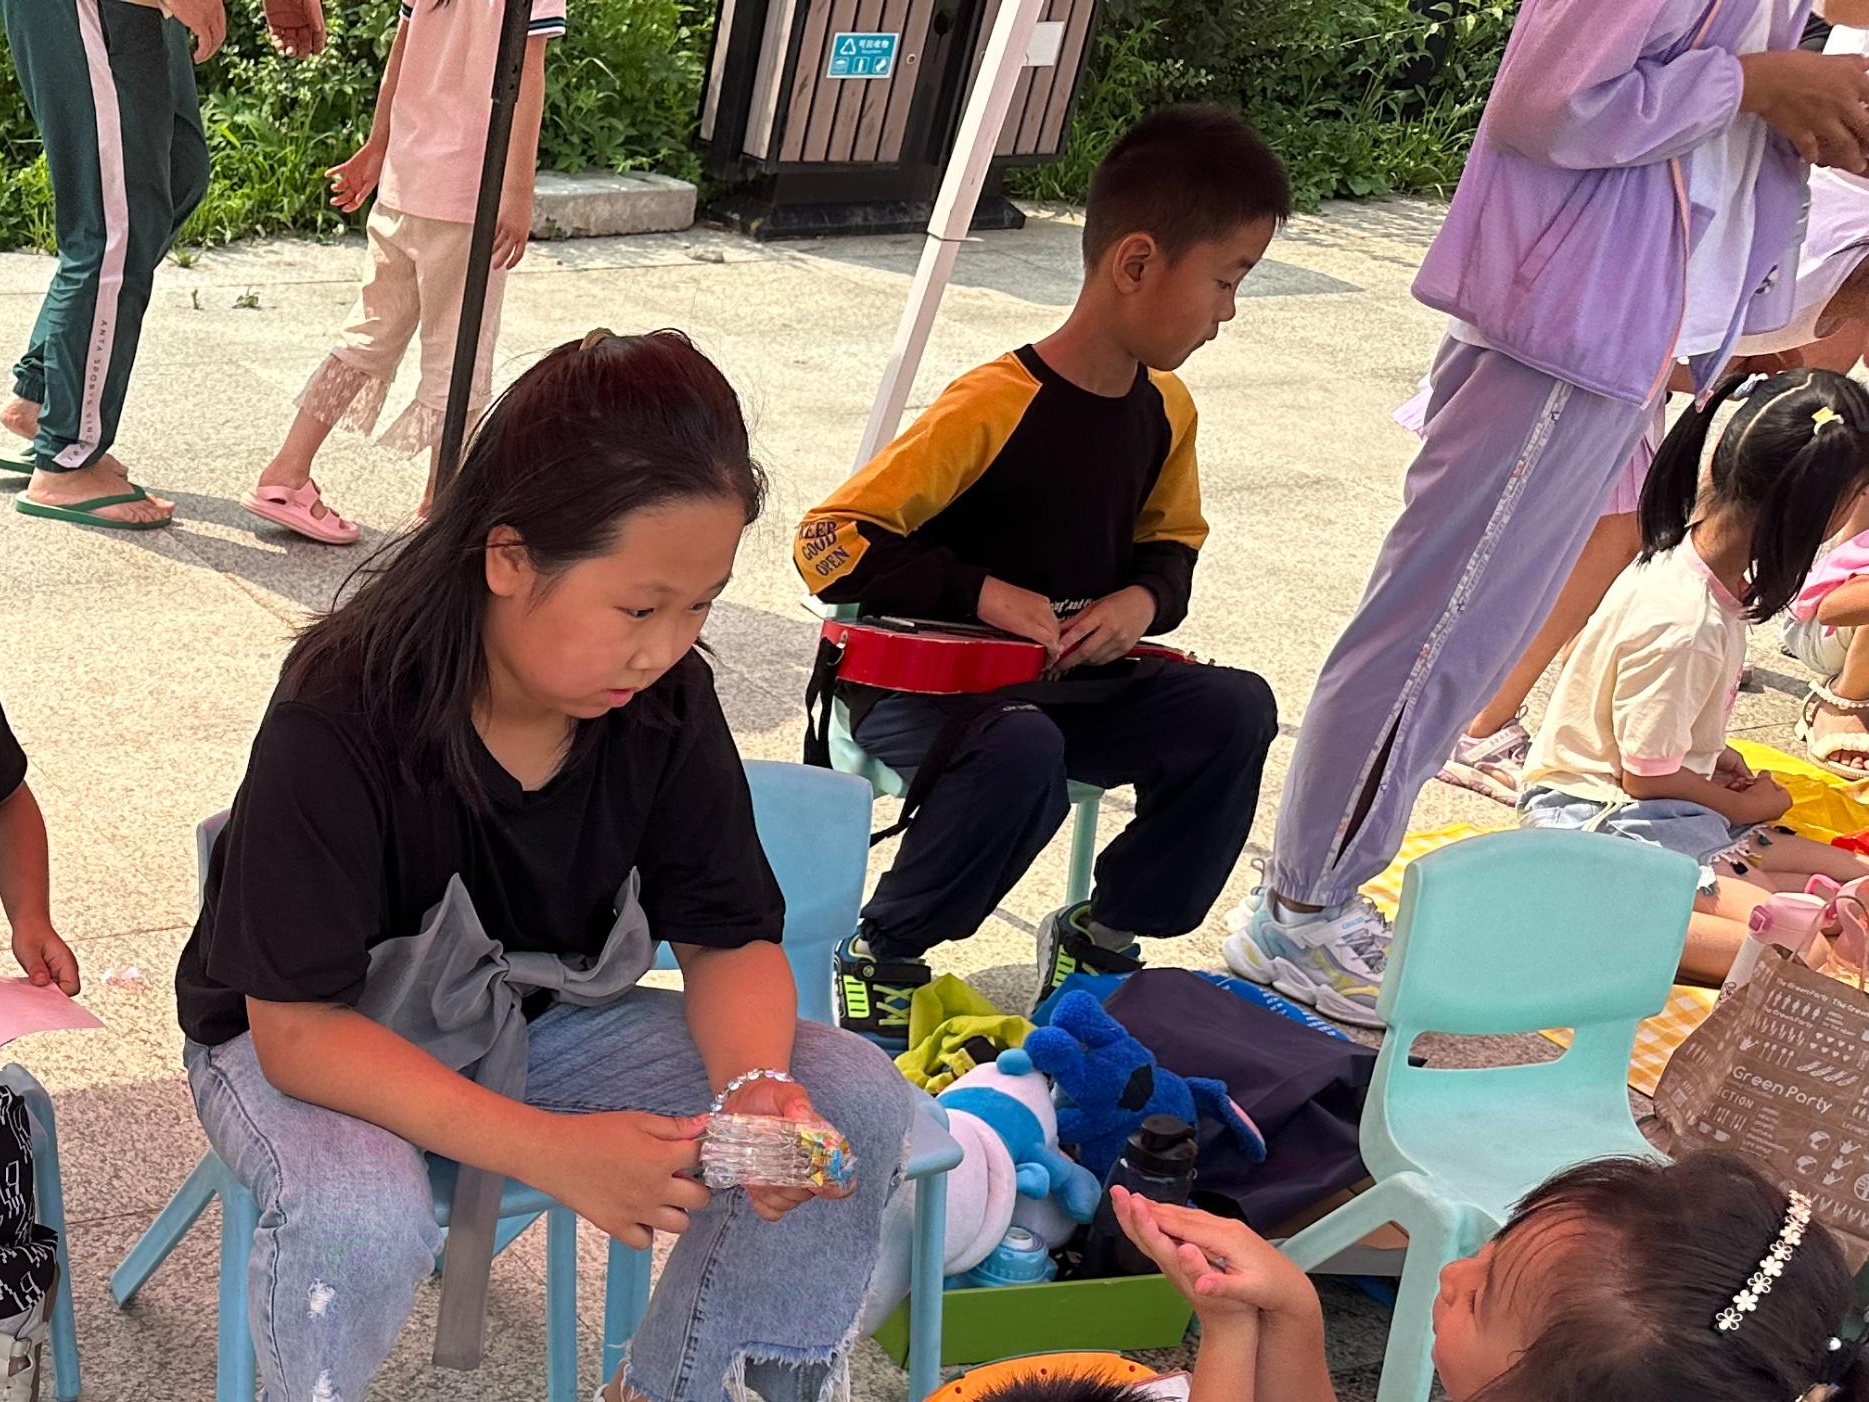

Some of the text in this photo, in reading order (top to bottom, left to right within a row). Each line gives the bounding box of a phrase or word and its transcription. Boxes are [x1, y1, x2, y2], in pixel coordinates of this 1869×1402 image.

[816, 545, 850, 576] OPEN
[1732, 1065, 1832, 1114] Green Party
